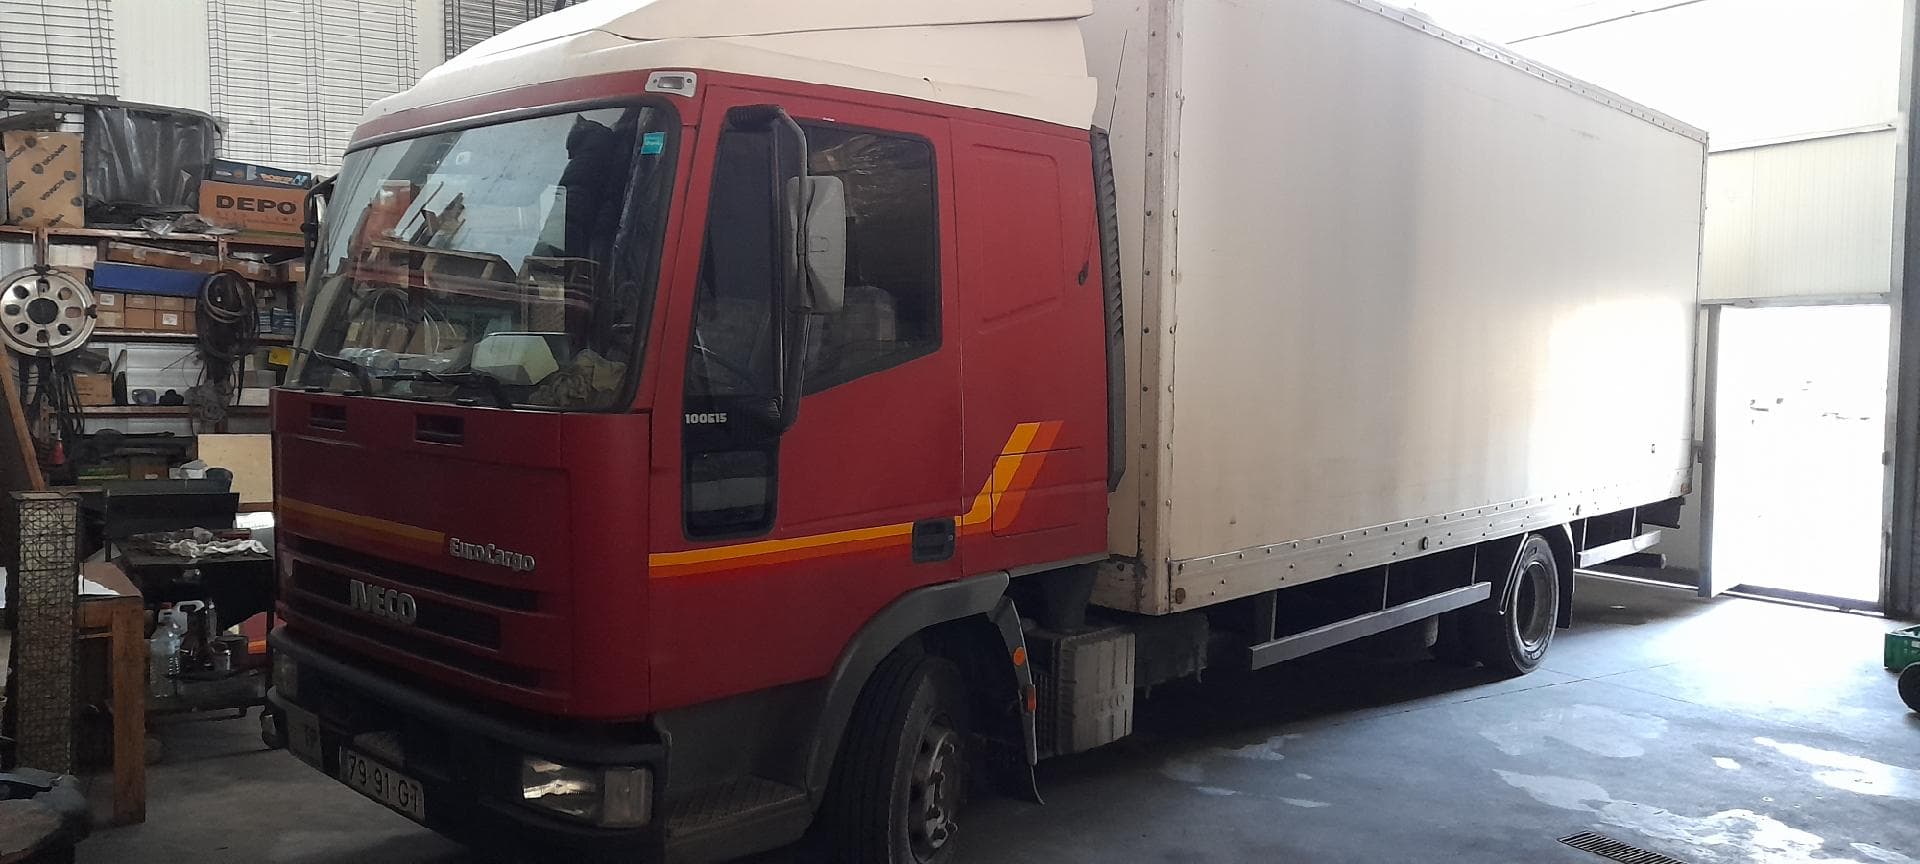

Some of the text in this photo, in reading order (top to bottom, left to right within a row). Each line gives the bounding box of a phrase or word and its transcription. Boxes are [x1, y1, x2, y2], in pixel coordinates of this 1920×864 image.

[216, 195, 297, 215] DEPO
[685, 413, 728, 424] 100E15
[450, 537, 536, 571] EuroCargo
[350, 579, 417, 625] IVECO
